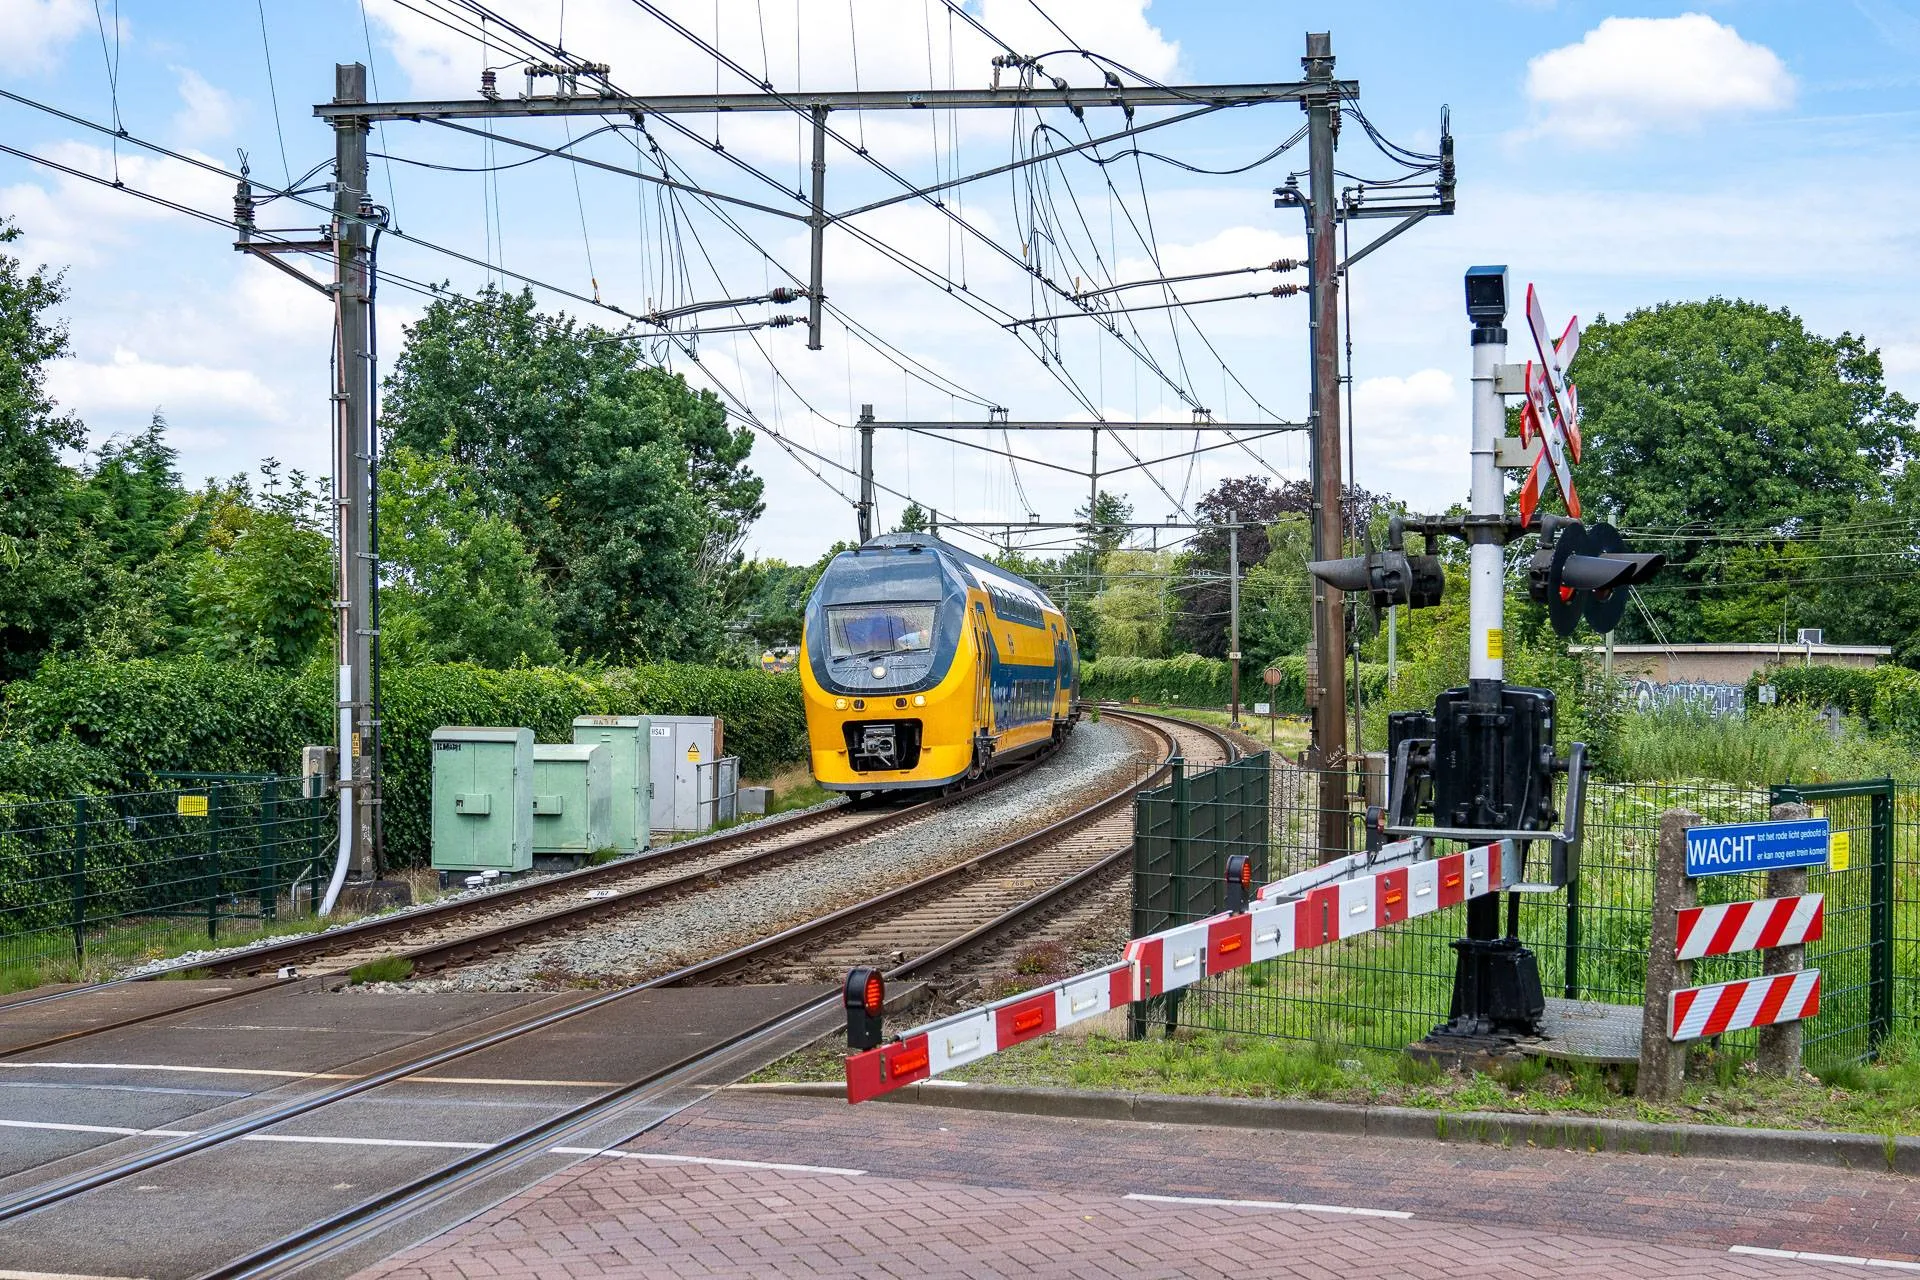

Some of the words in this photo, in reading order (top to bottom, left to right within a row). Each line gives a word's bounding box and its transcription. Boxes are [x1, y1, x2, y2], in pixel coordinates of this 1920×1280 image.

[652, 728, 665, 736] HS41
[1757, 832, 1765, 841] tot
[1766, 832, 1775, 841] het
[1775, 831, 1788, 840] rode
[1788, 830, 1800, 839] licht
[1800, 828, 1821, 840] gedoofd
[1821, 827, 1827, 837] is
[1688, 835, 1756, 867] WACHT
[1756, 852, 1763, 860] er
[1763, 851, 1774, 860] kan
[1774, 851, 1785, 861] nog
[1785, 850, 1796, 858] een
[1796, 847, 1809, 857] trein
[1809, 847, 1826, 856] komen
